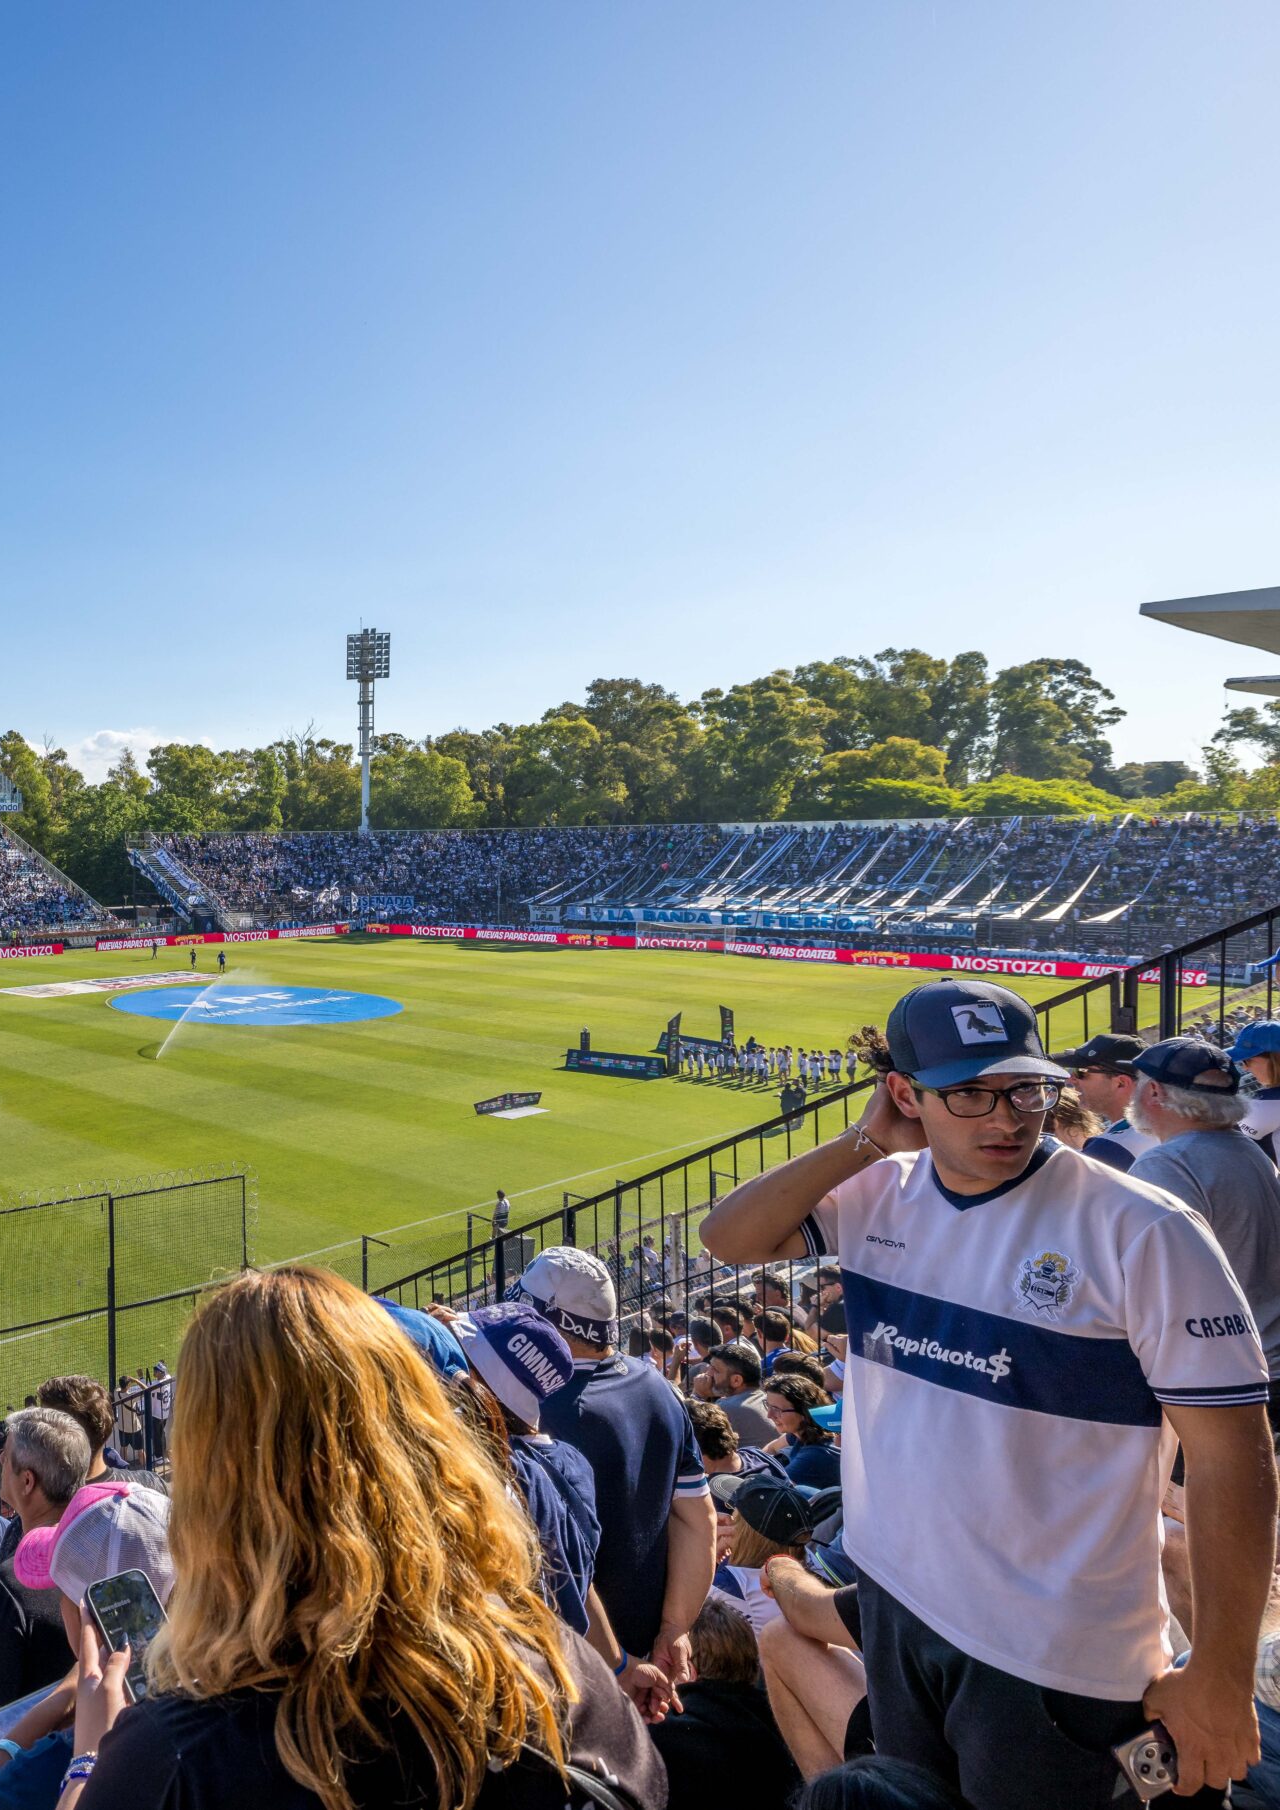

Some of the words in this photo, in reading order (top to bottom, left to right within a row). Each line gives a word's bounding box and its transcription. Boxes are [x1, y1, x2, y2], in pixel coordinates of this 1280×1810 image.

[608, 909, 634, 921] LA
[643, 910, 712, 924] BANDA
[721, 914, 751, 925] DE
[763, 913, 854, 931] FIERRO
[278, 929, 299, 938] NUEVAS
[300, 928, 317, 937] PAPAS
[476, 930, 503, 940] NUEVAS
[504, 931, 528, 941] PAPAS
[98, 941, 122, 951] NUEVAS
[122, 940, 143, 949] PAPAS
[725, 943, 762, 954] NUEVAS
[866, 1234, 906, 1250] GIVOVA
[559, 1310, 601, 1343] Dale
